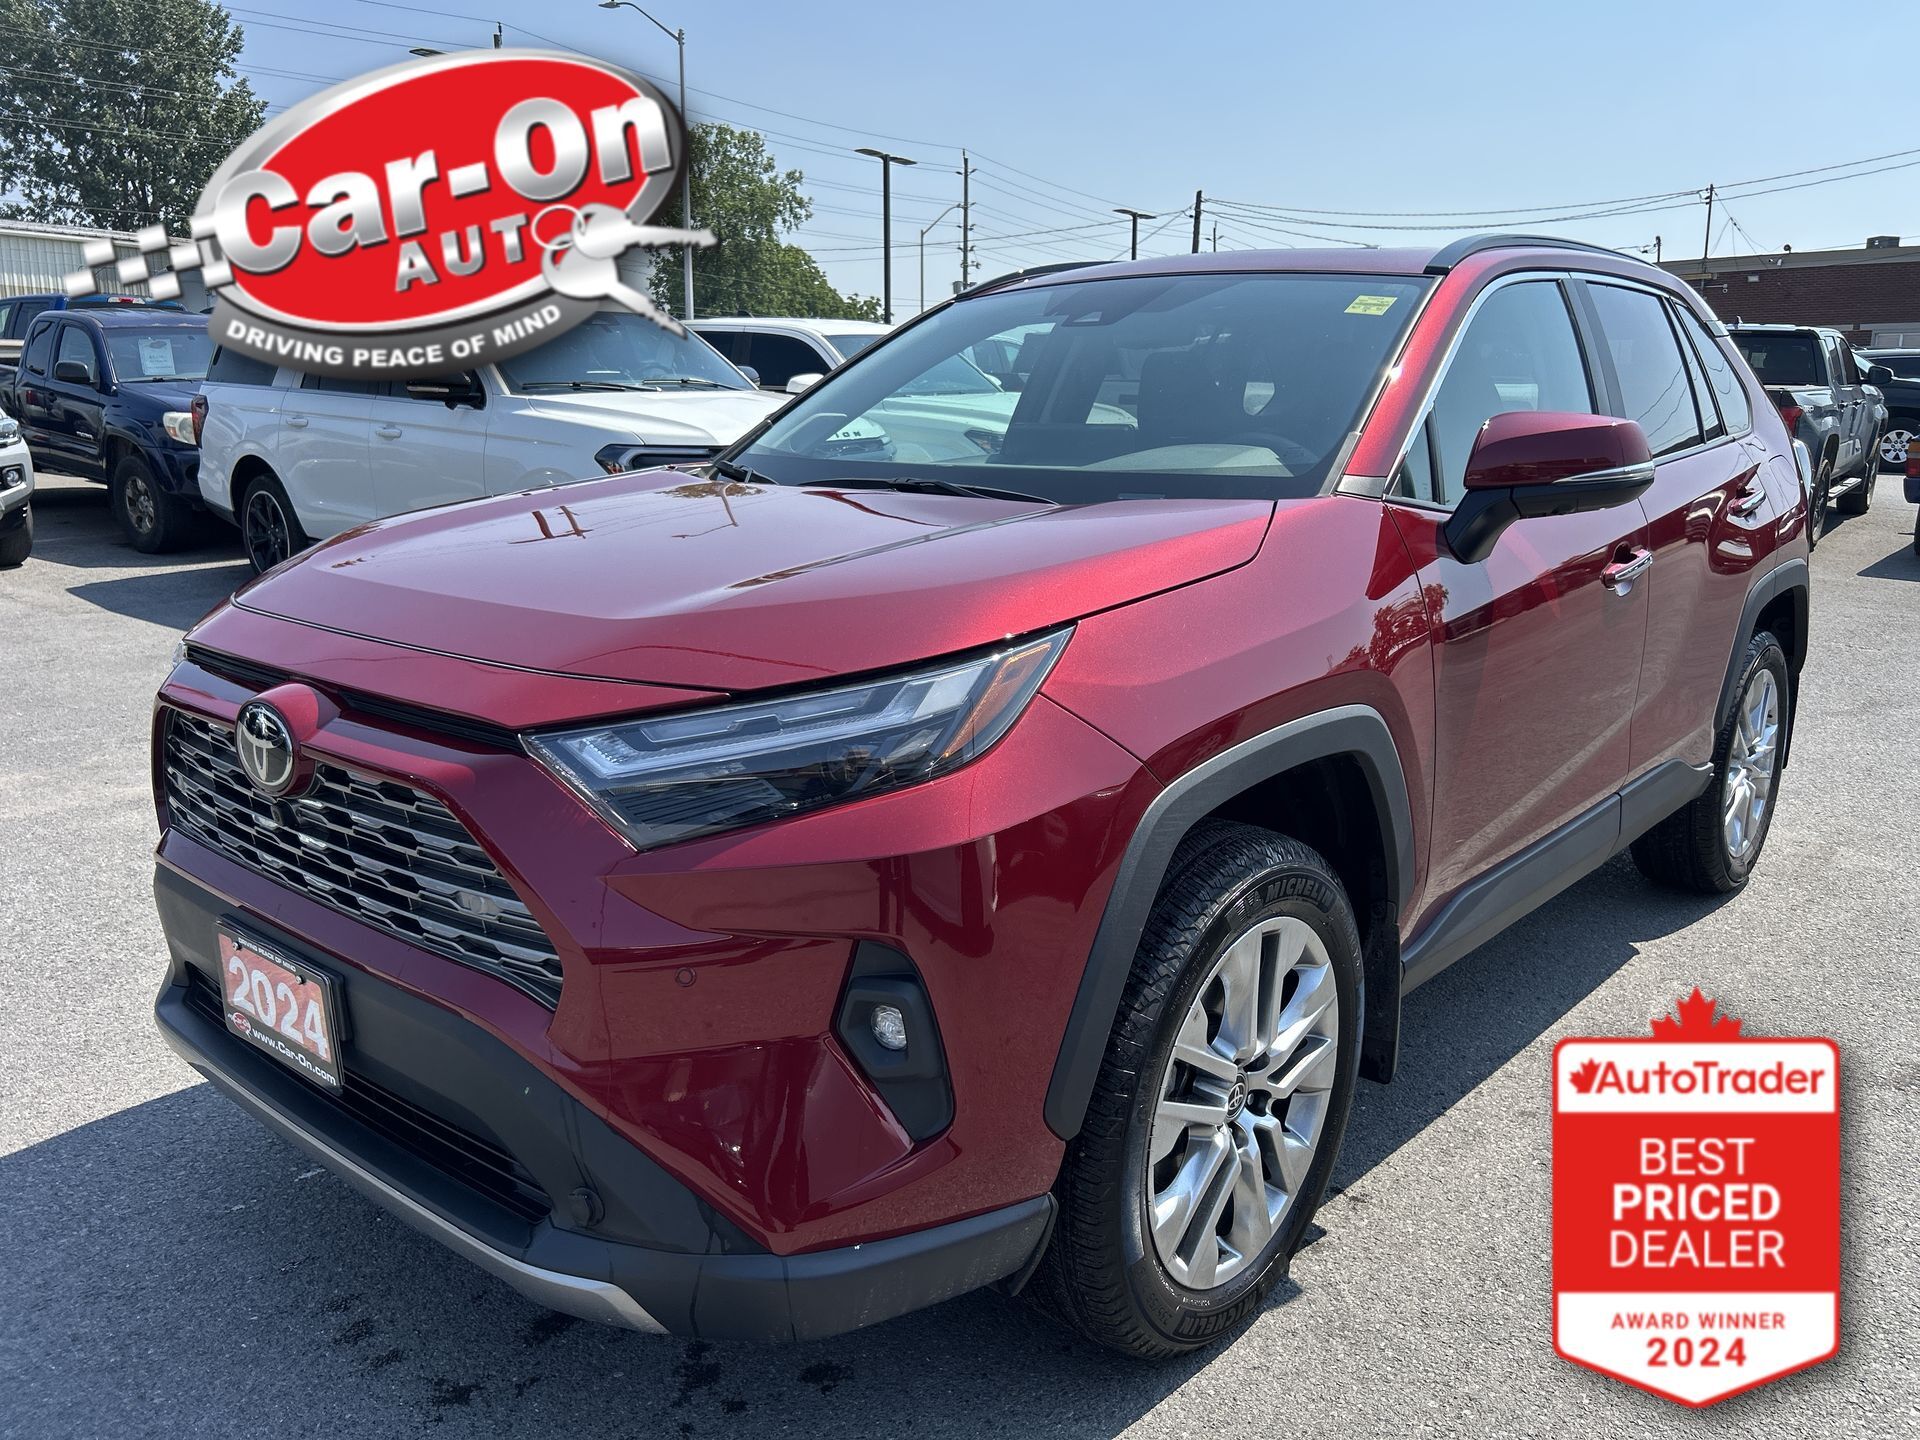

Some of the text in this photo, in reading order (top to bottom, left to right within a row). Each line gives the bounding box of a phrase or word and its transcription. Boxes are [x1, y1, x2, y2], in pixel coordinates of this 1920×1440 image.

[1266, 878, 1334, 907] MICHELIN
[228, 956, 329, 1059] 2024
[252, 1028, 337, 1087] www.Car-On.com
[1179, 1290, 1257, 1335] MICHELIN
